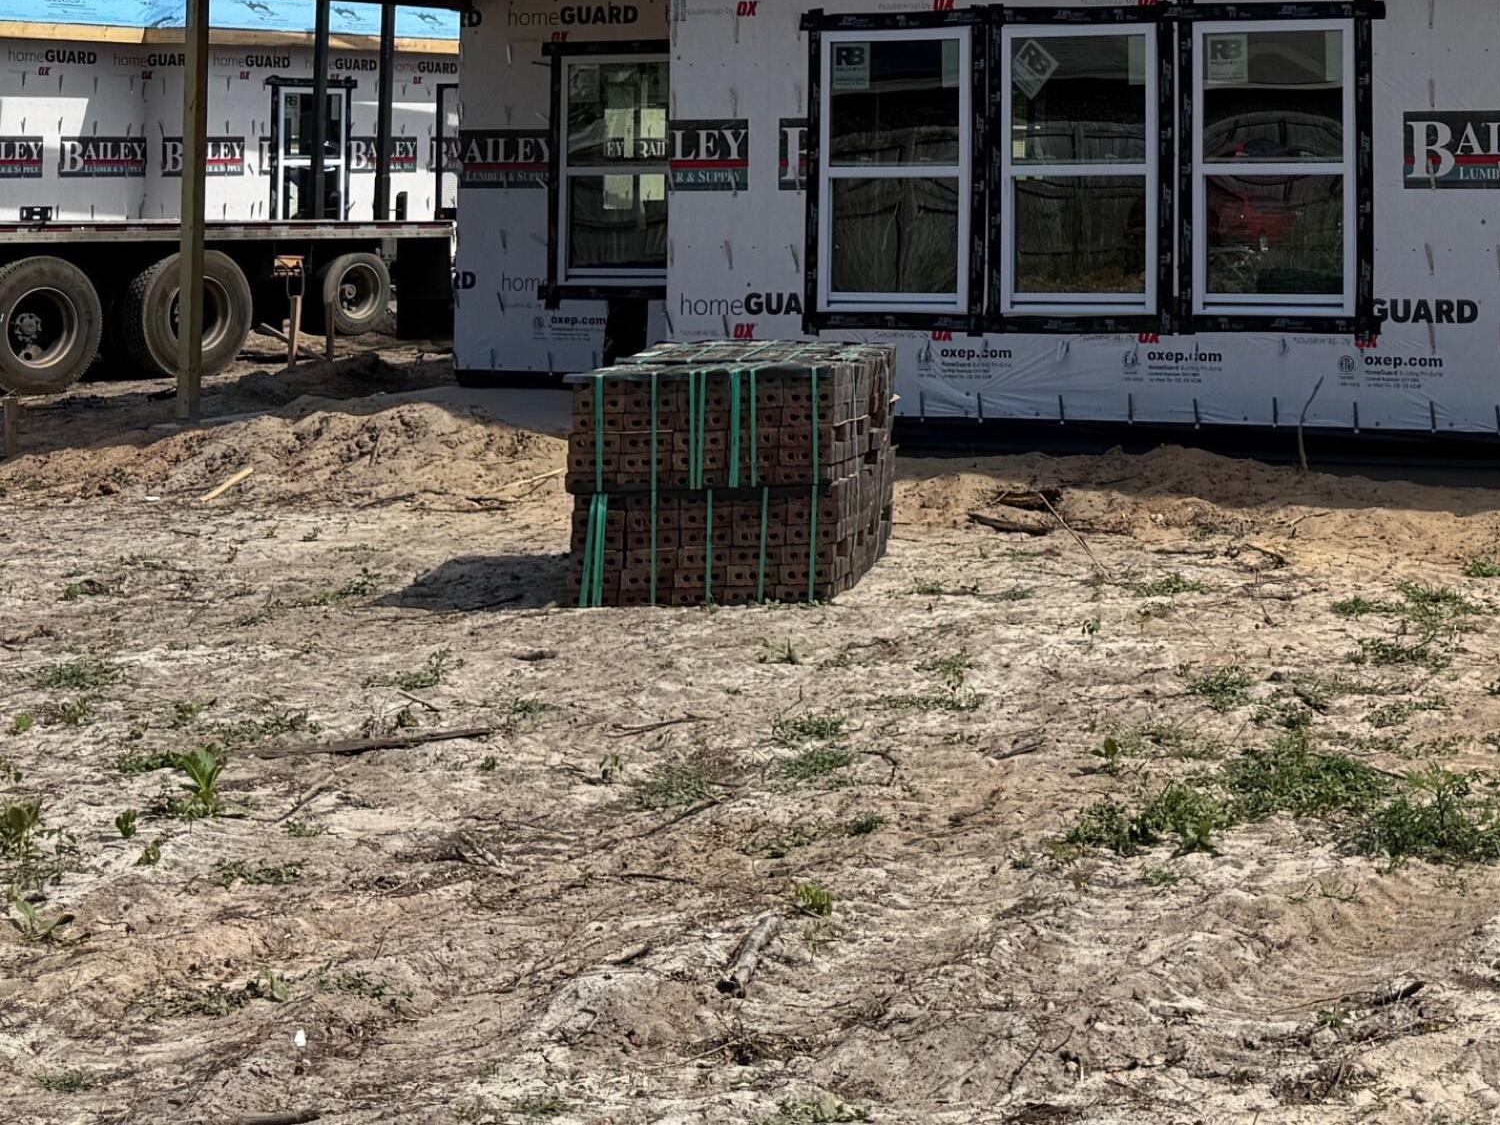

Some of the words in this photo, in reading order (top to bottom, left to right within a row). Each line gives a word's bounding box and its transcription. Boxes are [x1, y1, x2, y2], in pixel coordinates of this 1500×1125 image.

[508, 5, 638, 26] homeGUARD
[736, 0, 758, 17] OX
[8, 49, 97, 65] homeGUARD
[113, 51, 185, 67] homeGUAR
[213, 55, 291, 68] homeGUARD
[836, 47, 865, 65] RB
[0, 142, 42, 160] LEY
[207, 142, 244, 160] LEY
[464, 138, 549, 163] AILEY
[672, 129, 748, 160] LEY
[62, 141, 145, 172] BAILEY
[680, 292, 803, 316] homeGUA
[1372, 298, 1479, 324] GUARD
[734, 323, 755, 339] OX
[941, 348, 1012, 361] oxep.com
[1364, 355, 1443, 368] oxep.com
